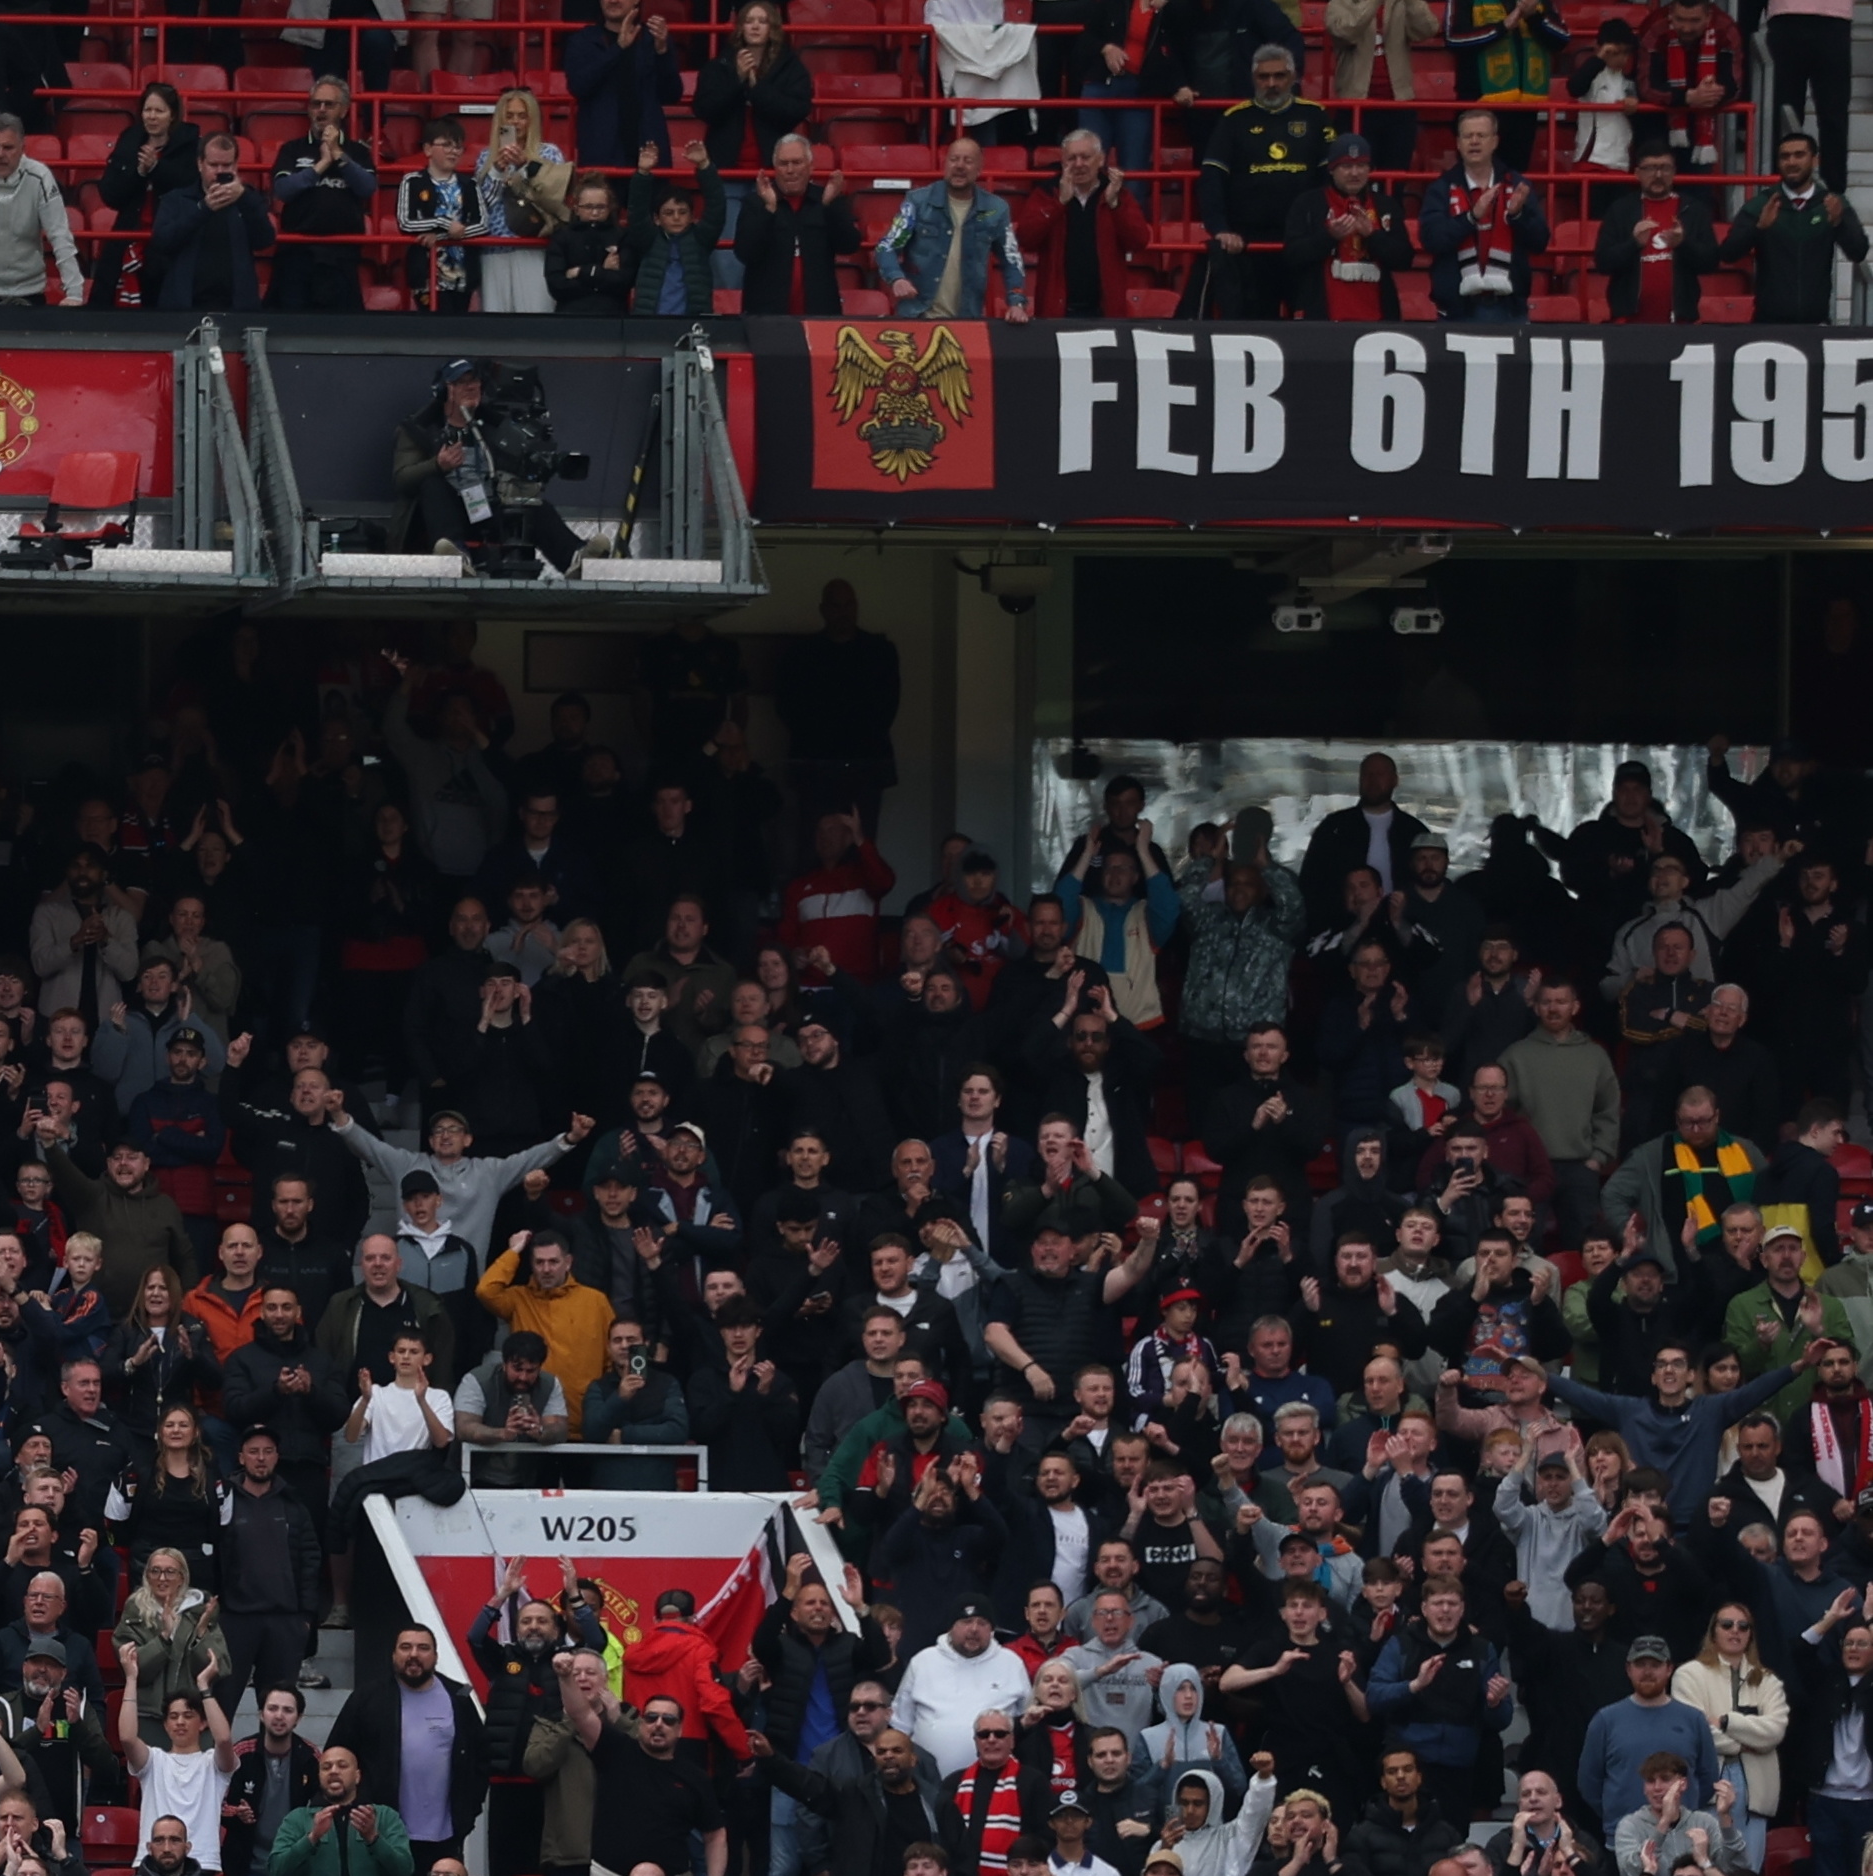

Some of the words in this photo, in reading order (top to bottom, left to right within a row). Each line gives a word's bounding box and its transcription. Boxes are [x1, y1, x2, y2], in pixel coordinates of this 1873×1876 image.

[1056, 327, 1286, 477] FEB
[1349, 330, 1607, 482] 6TH
[540, 1515, 636, 1542] W205
